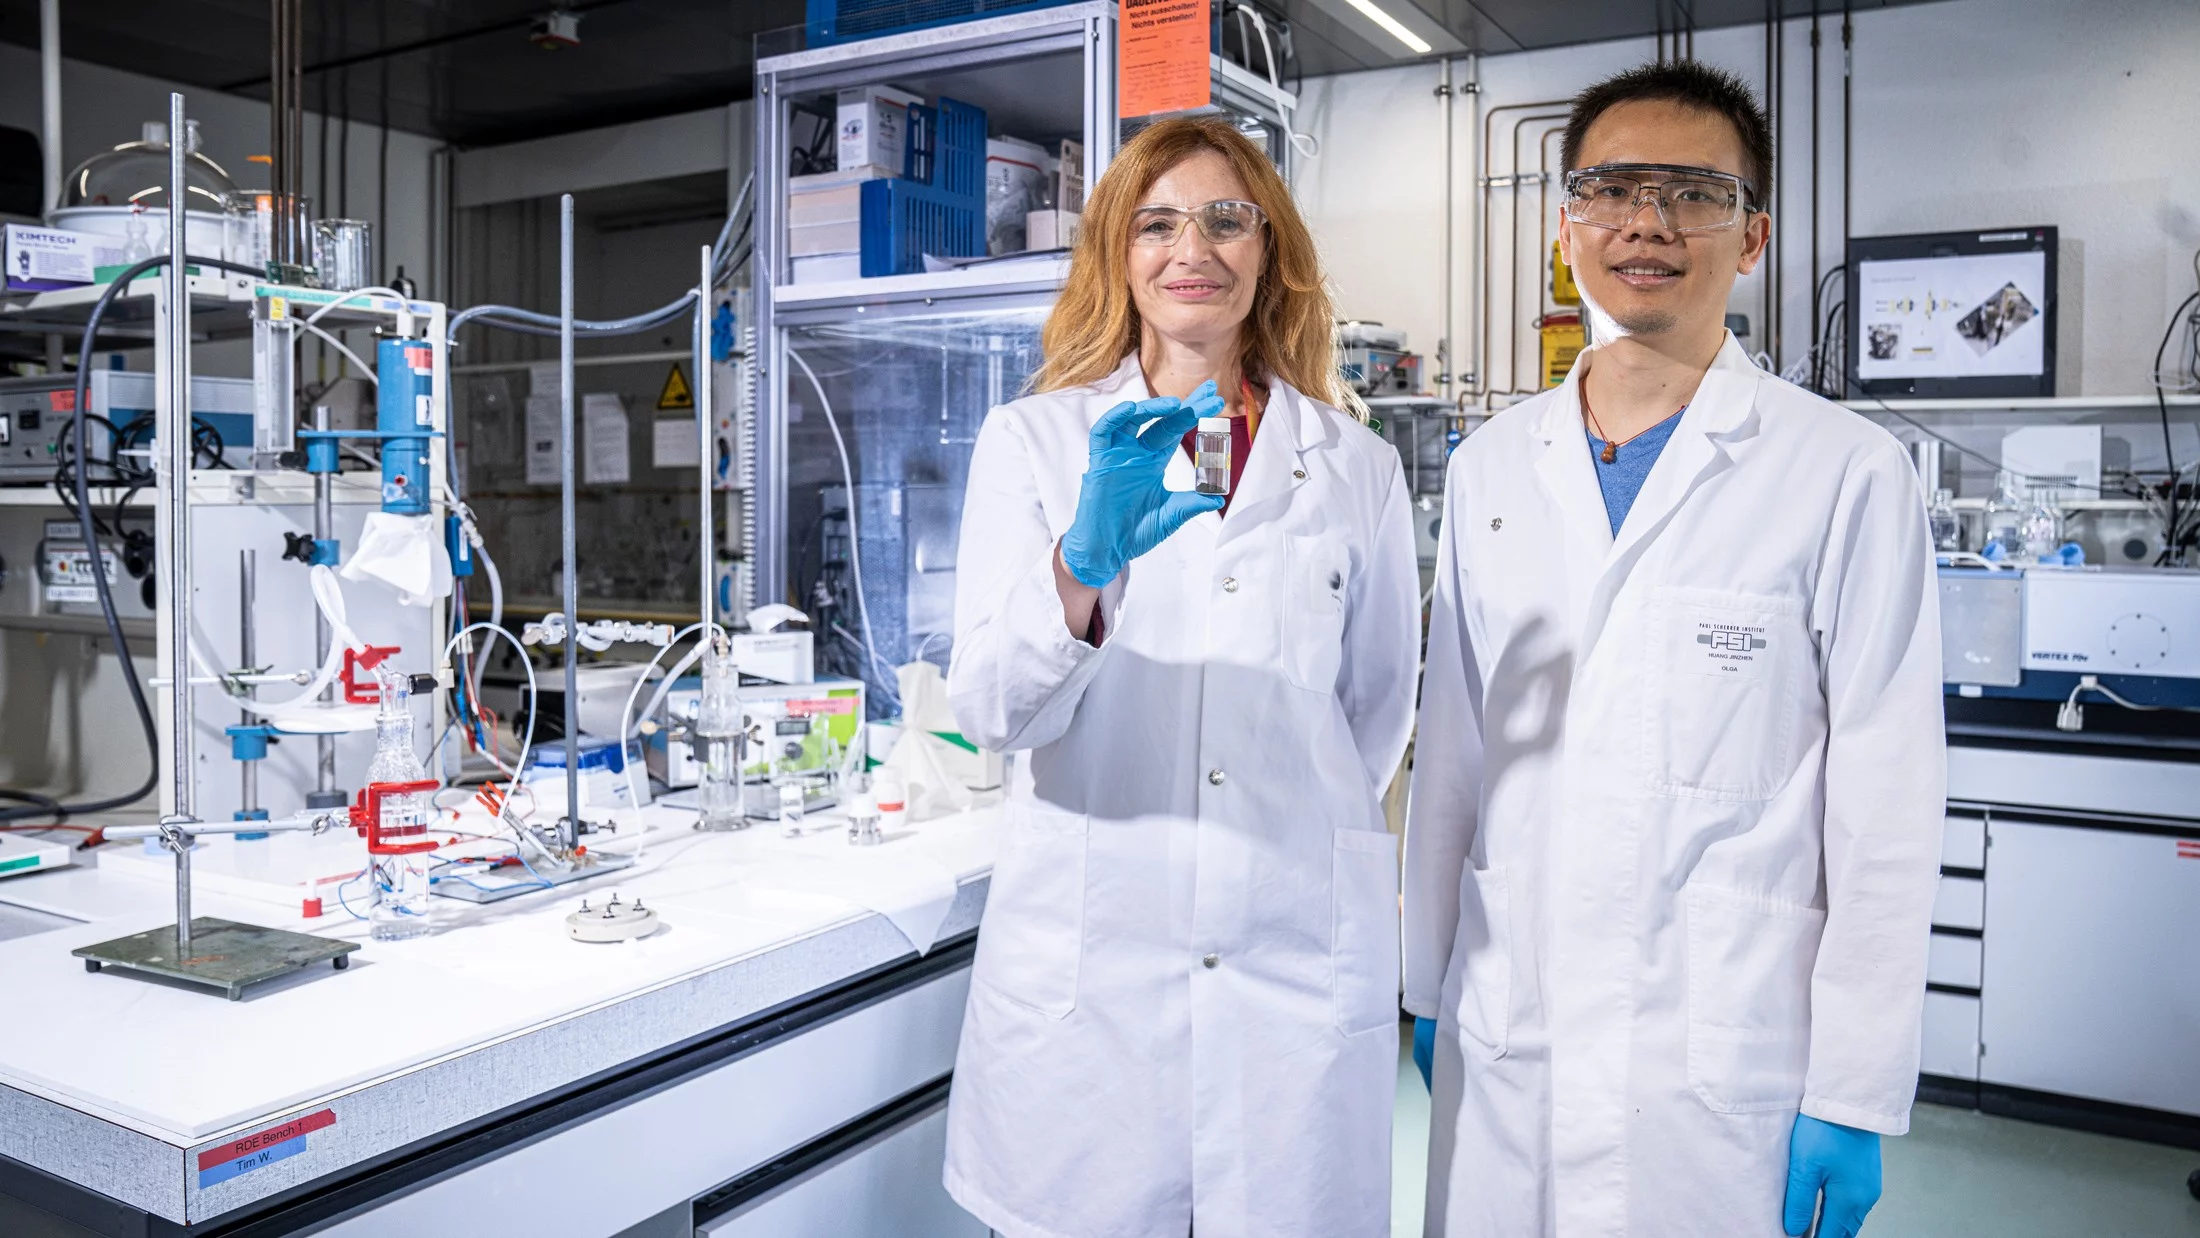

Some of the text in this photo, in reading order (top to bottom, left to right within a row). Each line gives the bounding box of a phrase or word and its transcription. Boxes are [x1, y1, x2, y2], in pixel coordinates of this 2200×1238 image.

[1129, 1, 1199, 19] Nicht ausschalten!
[1131, 12, 1196, 29] Nichts verstellen!
[16, 231, 76, 244] KIMTECH
[1711, 630, 1752, 652] PSI
[235, 1122, 302, 1153] RDE Bench 1
[236, 1151, 272, 1171] Tim W.
